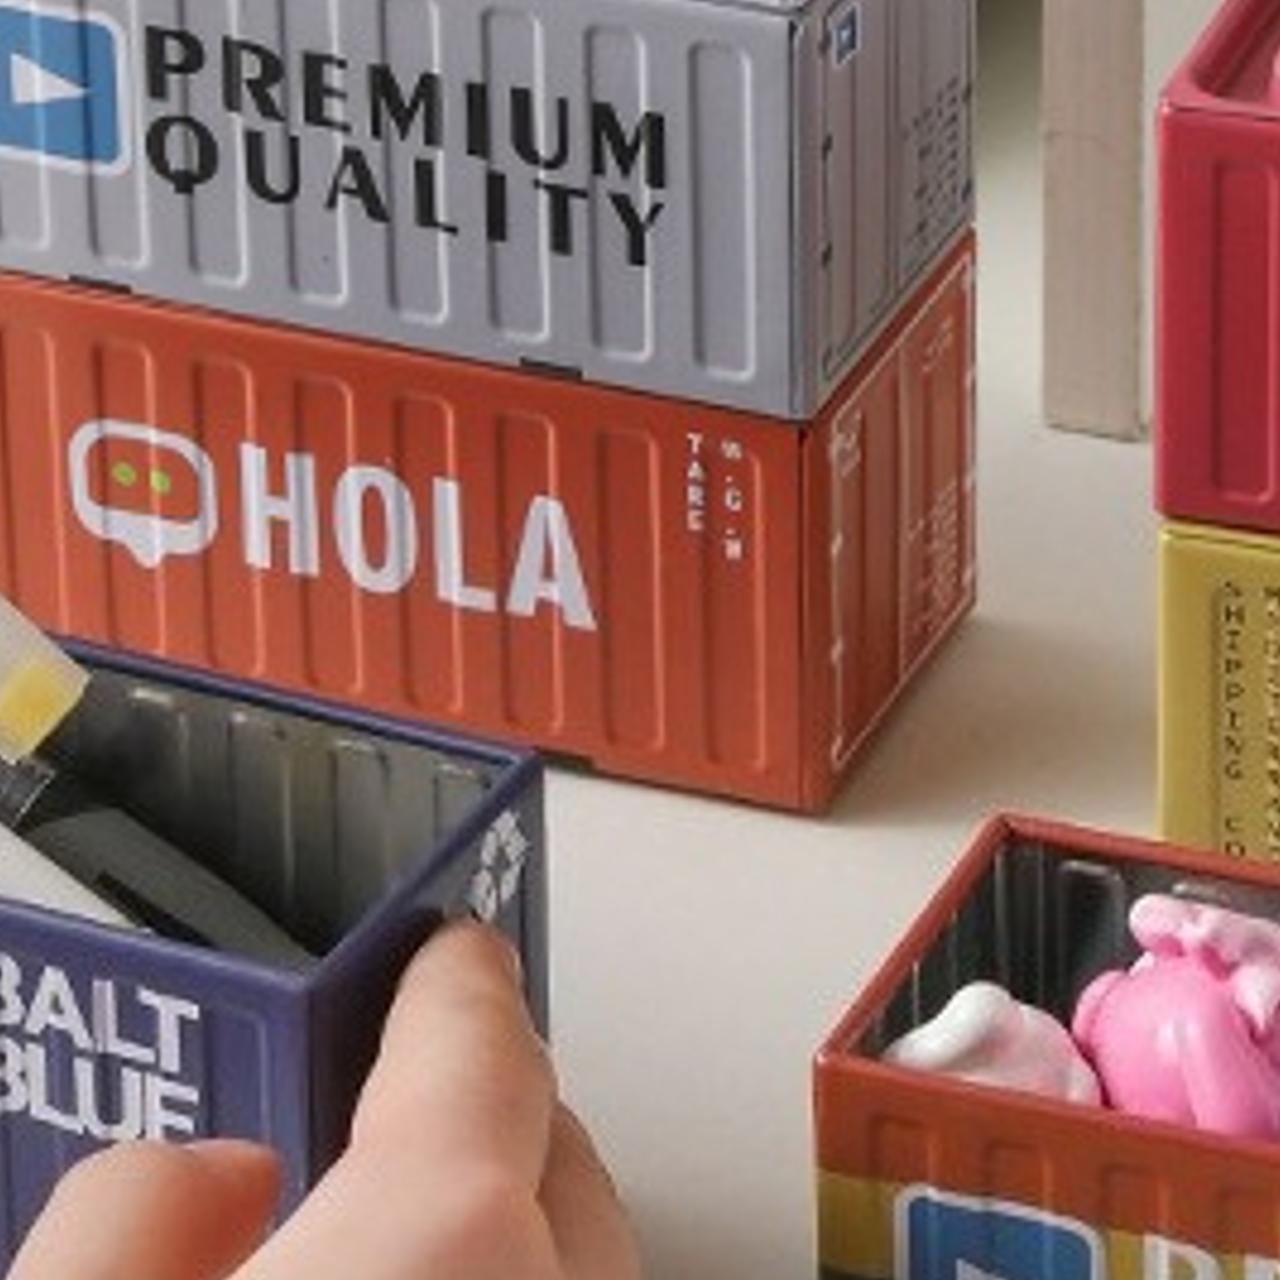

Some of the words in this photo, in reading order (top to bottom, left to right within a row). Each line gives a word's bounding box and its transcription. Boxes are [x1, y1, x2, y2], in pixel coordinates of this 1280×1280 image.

[145, 24, 667, 189] PREMIUM
[144, 115, 664, 266] QUALITY
[239, 441, 597, 630] HOLA
[686, 431, 705, 531] TARE
